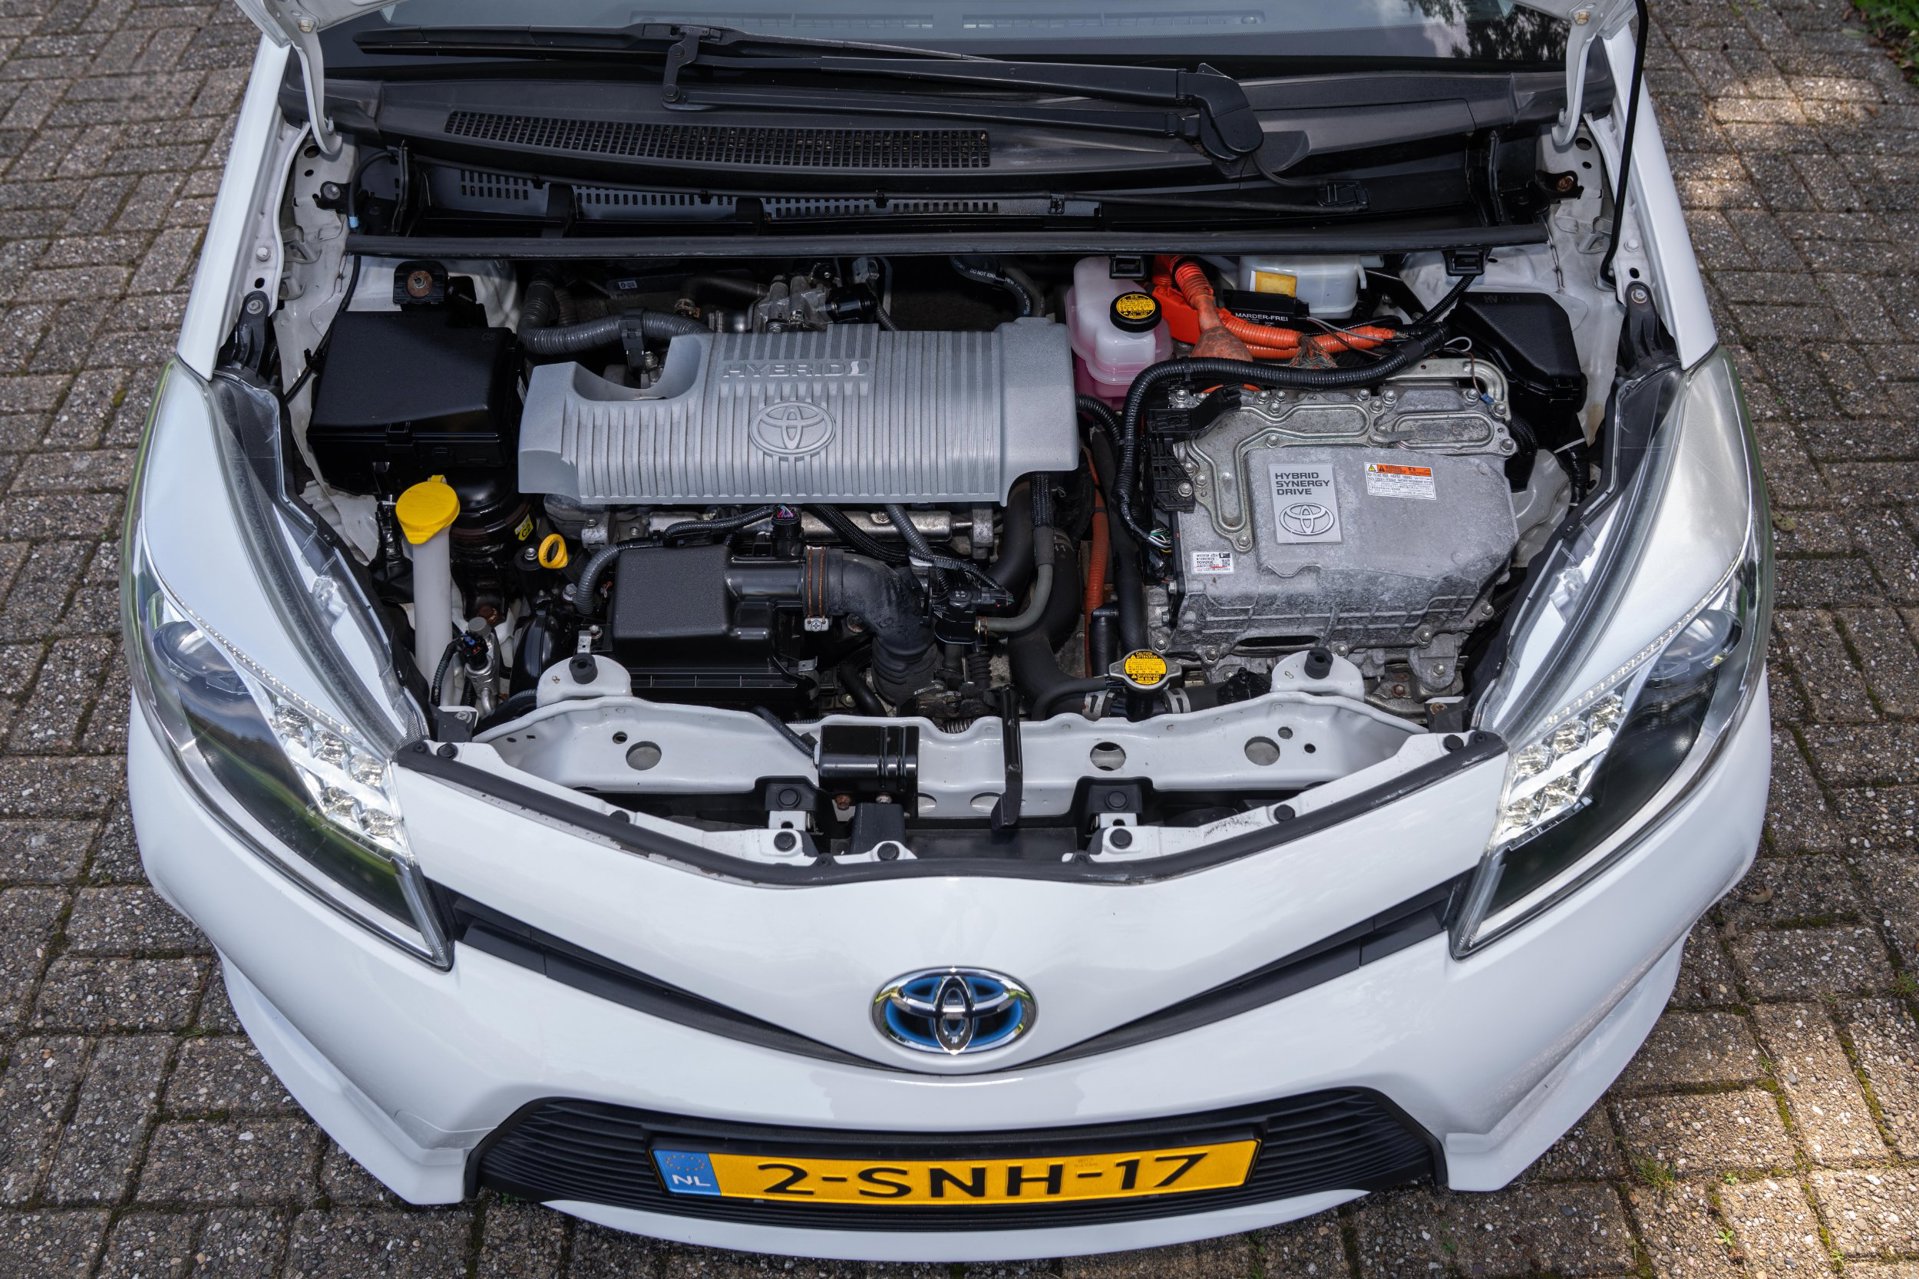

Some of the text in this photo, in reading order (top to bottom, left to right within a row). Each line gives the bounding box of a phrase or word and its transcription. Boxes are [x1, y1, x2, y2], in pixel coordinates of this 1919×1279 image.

[1235, 312, 1289, 322] MARDER-FREI
[1275, 472, 1319, 480] HYBRID
[1275, 480, 1330, 488] SYNERGY
[1276, 488, 1313, 496] DRIVE
[757, 1152, 1209, 1199] 2-SNH-17
[672, 1174, 711, 1188] NL
